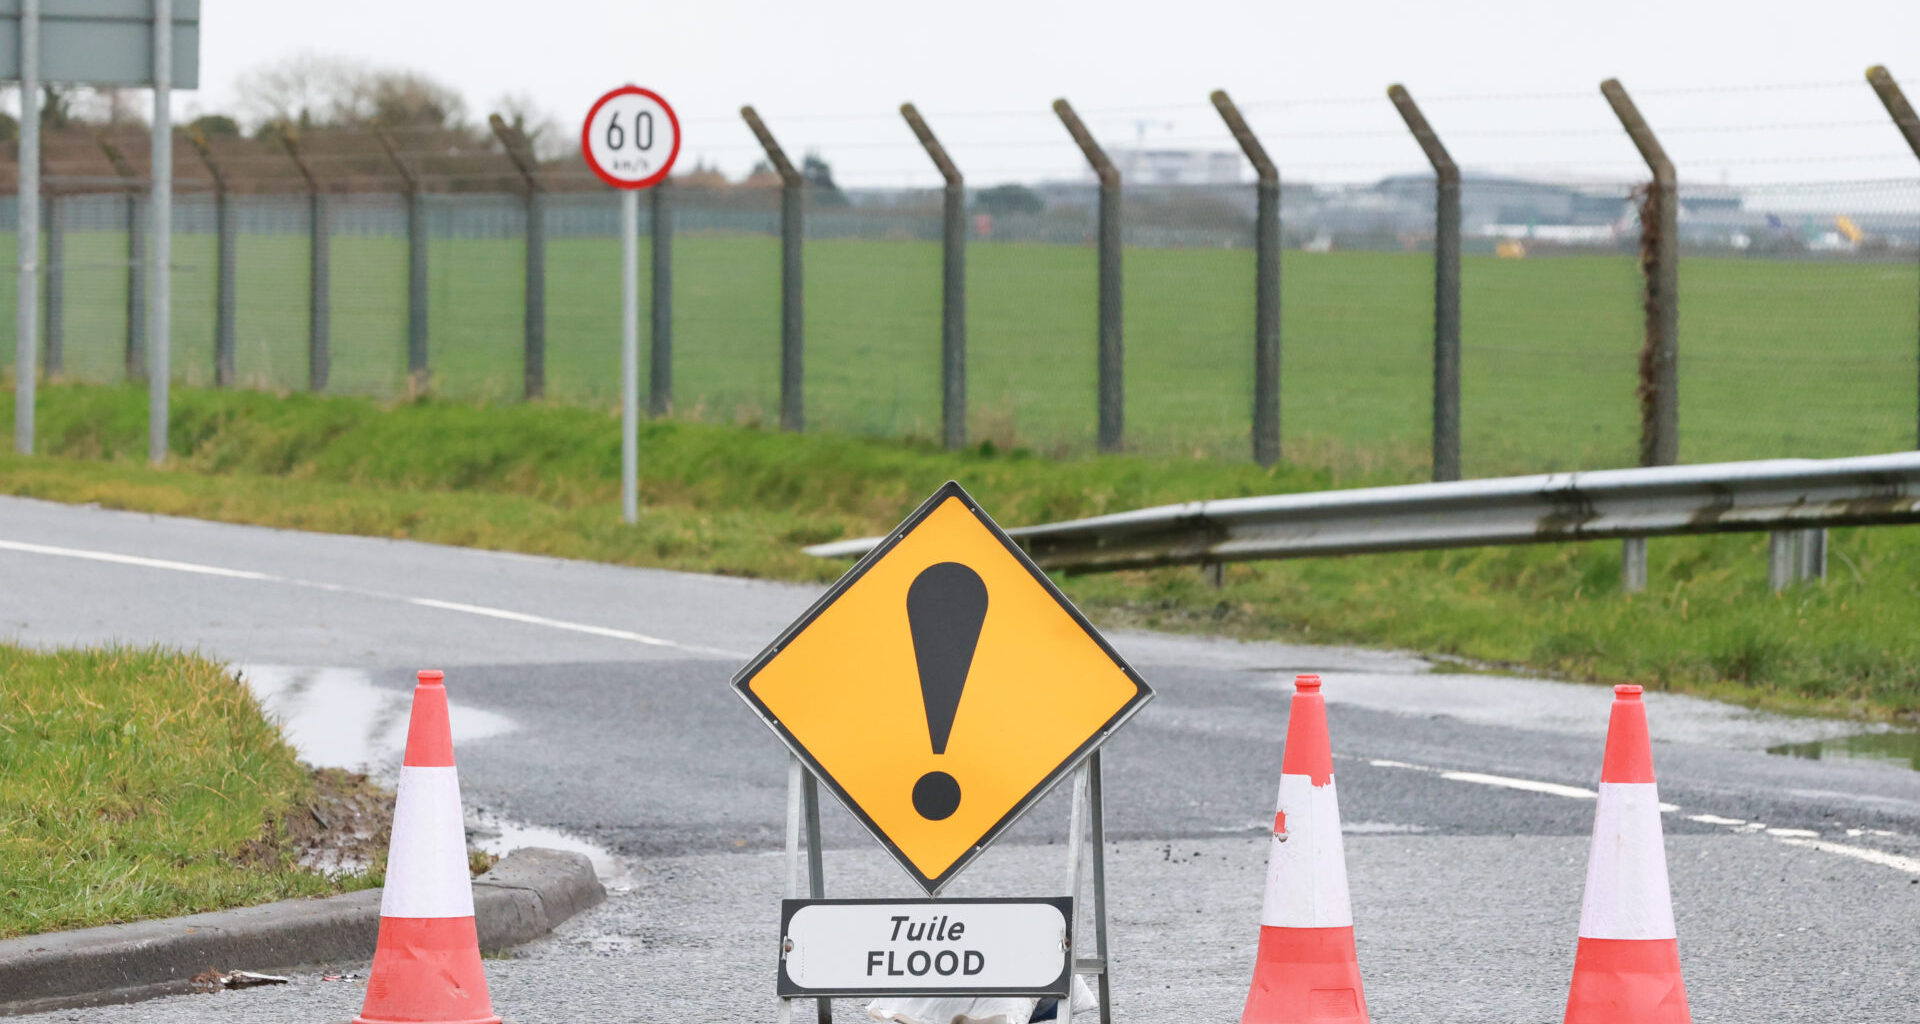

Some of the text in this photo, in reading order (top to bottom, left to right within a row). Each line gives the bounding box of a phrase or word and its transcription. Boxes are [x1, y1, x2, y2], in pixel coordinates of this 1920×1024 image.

[606, 110, 653, 151] 60
[889, 915, 965, 942] Tuile
[866, 949, 985, 977] FLOOD
